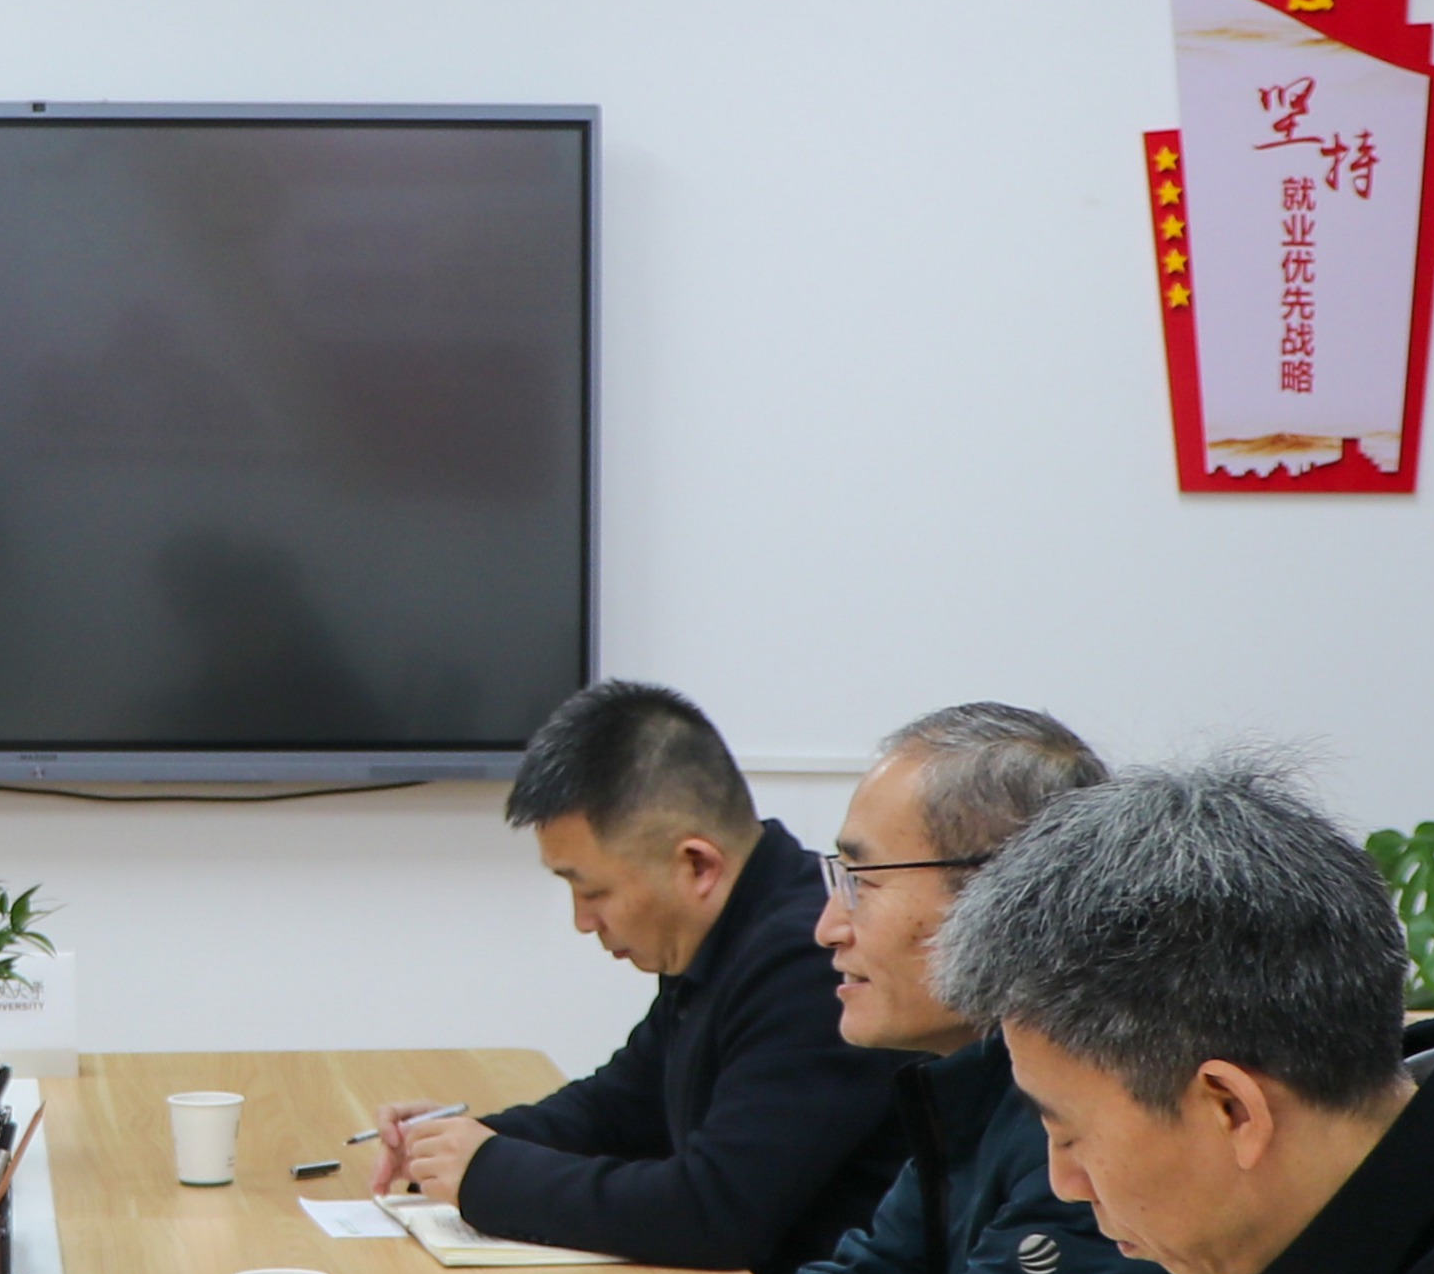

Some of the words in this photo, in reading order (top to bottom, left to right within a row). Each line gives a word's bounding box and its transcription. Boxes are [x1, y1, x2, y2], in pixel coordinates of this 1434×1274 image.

[1253, 76, 1381, 199] 坚持
[1280, 177, 1316, 394] 就业优先战略
